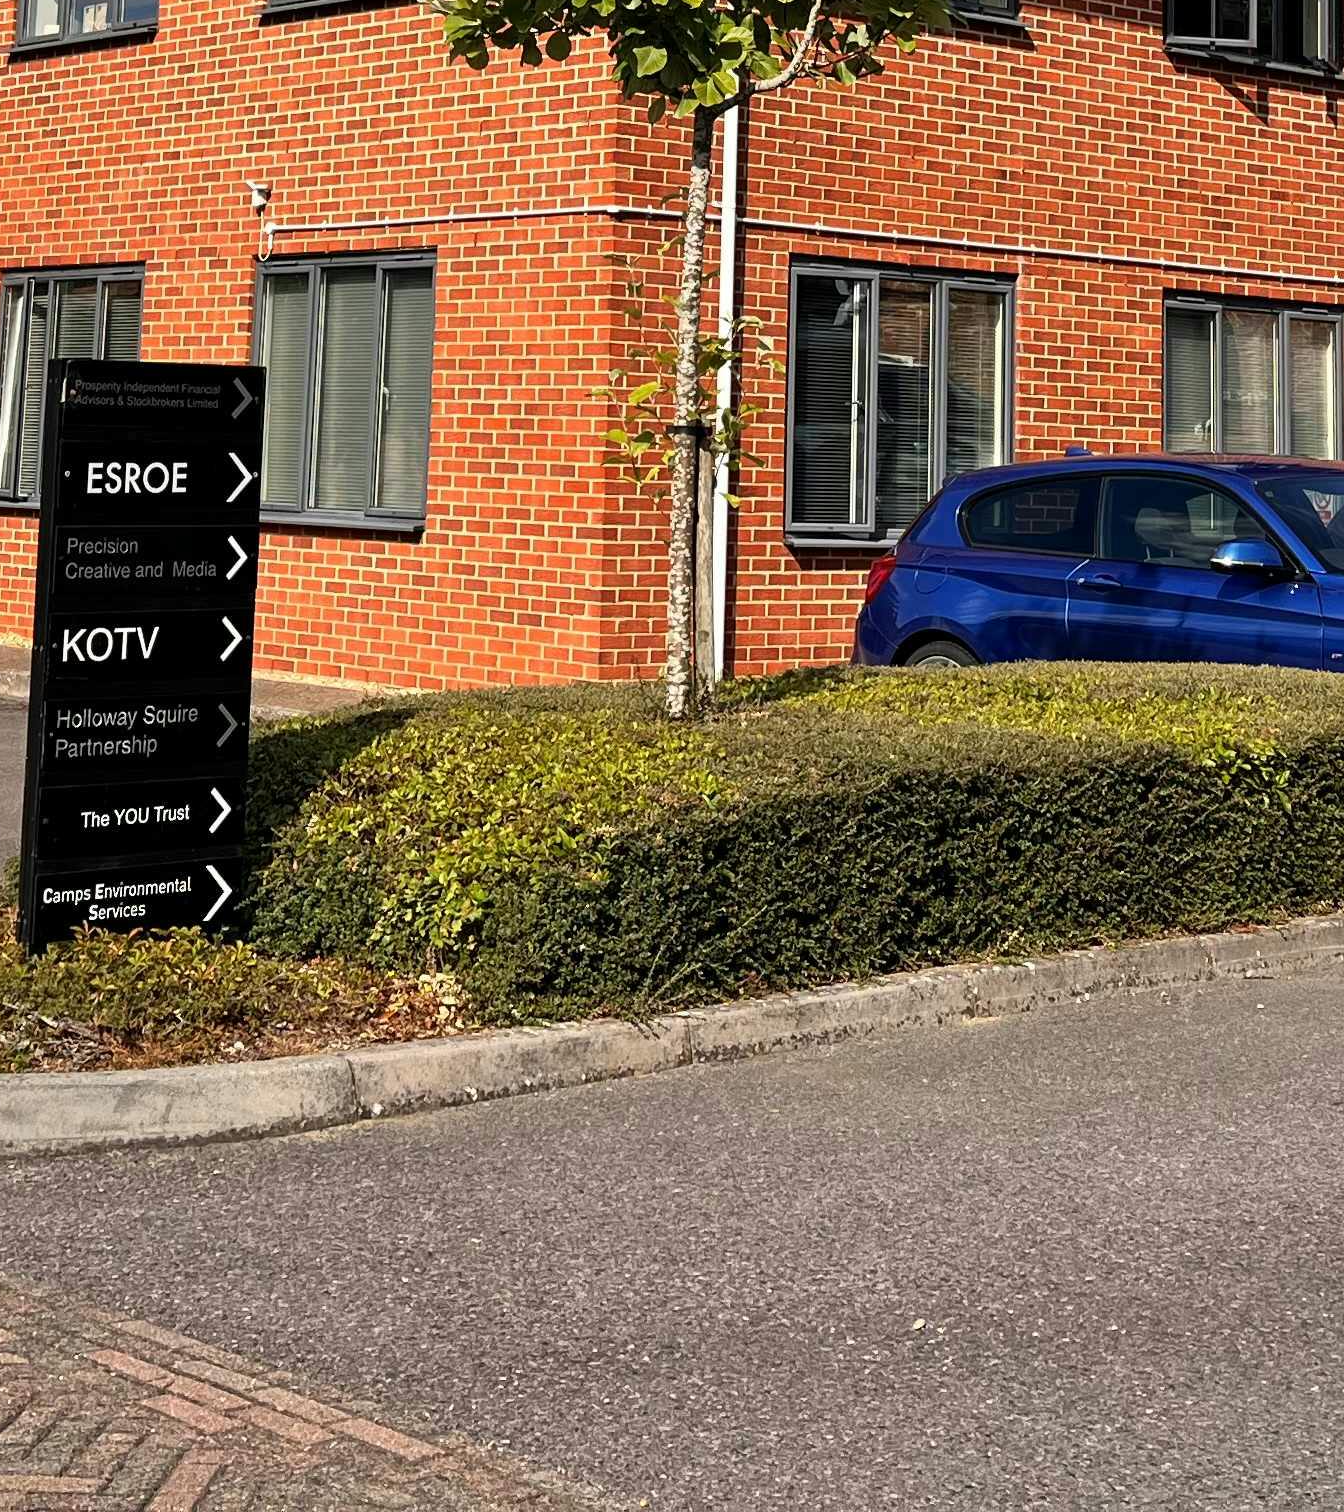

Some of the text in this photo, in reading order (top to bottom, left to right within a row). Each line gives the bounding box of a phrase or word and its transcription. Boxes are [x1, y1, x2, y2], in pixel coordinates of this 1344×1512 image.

[123, 381, 180, 395] Independent
[181, 383, 221, 395] Financial
[74, 395, 219, 409] Advisors & Stockbrokers Limited
[86, 461, 188, 494] ESROE
[66, 537, 139, 555] Precision
[65, 560, 217, 580] Creative and Media
[62, 626, 160, 662] KOTV
[56, 703, 199, 730] Holloway Squire
[55, 735, 158, 758] Partnership
[80, 804, 190, 829] The YOU Trust
[43, 876, 192, 905] Camps Environmental
[88, 904, 146, 921] Services
